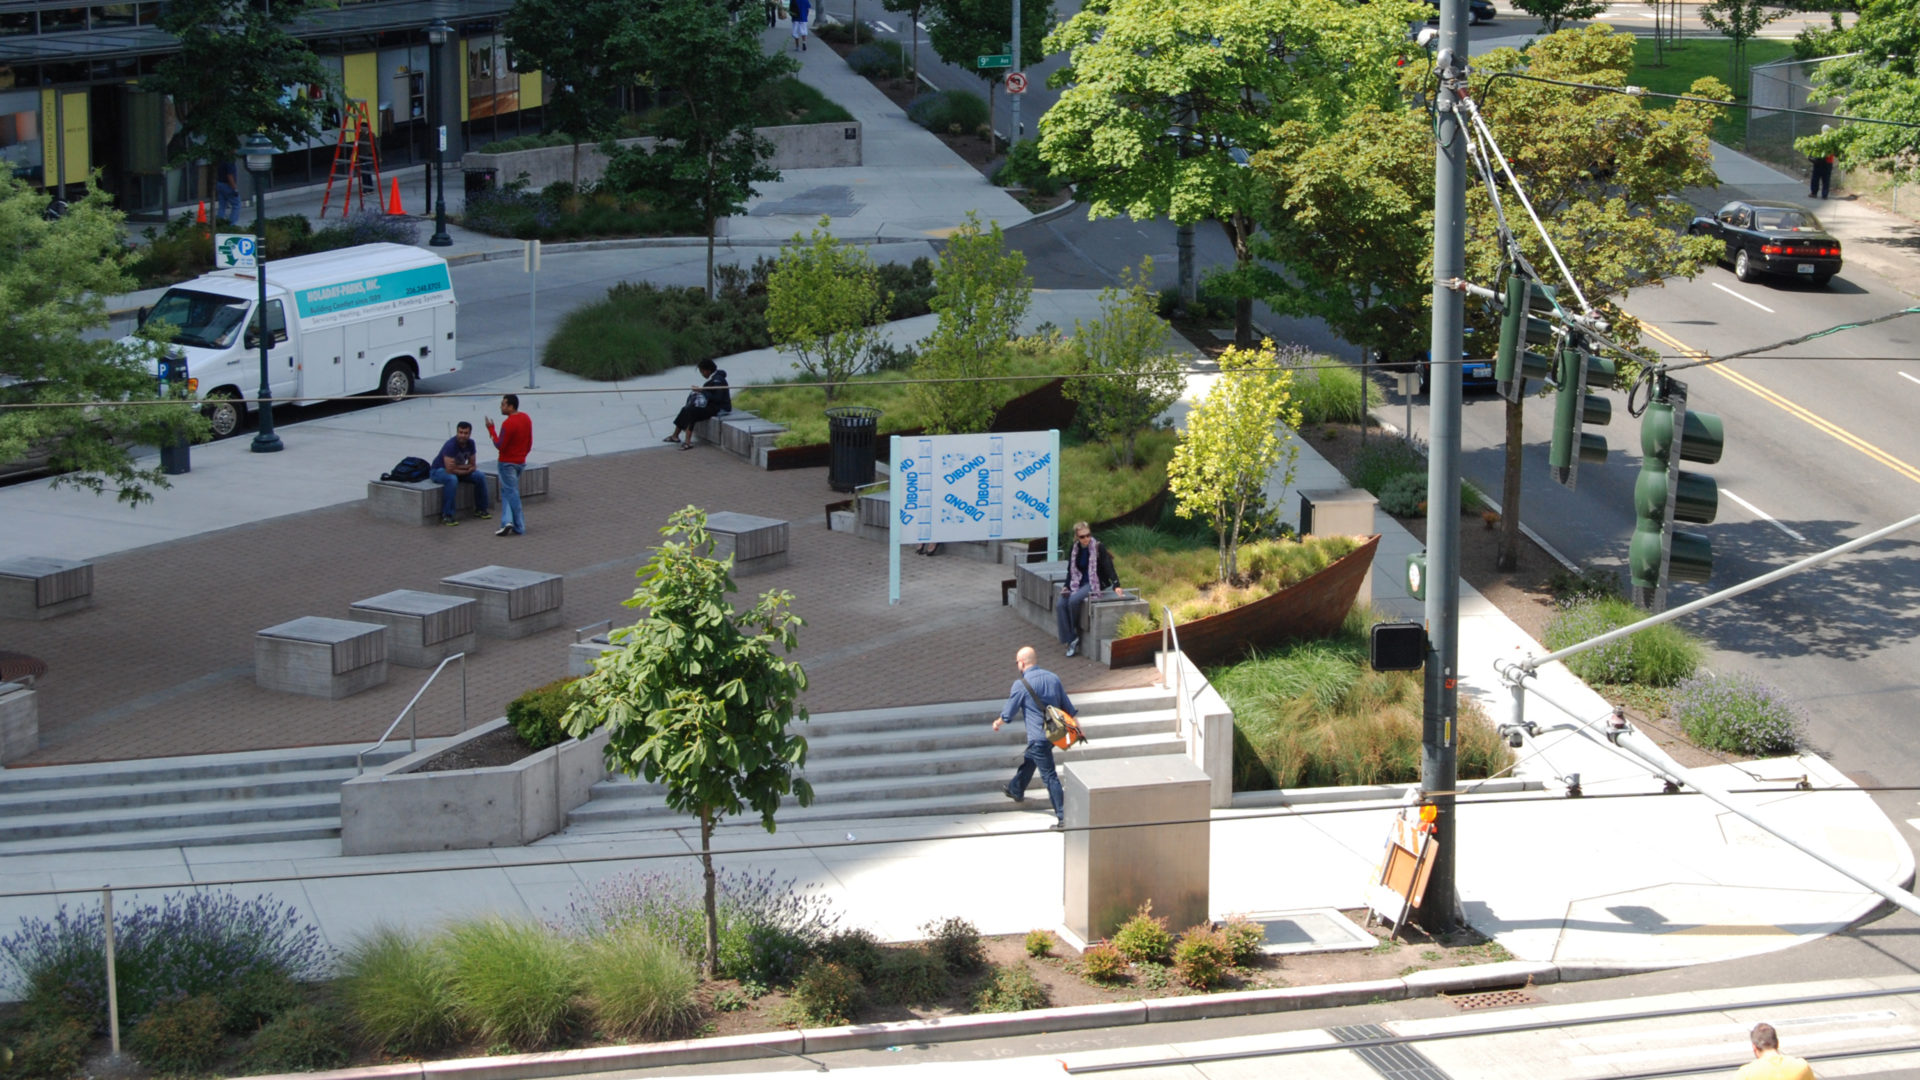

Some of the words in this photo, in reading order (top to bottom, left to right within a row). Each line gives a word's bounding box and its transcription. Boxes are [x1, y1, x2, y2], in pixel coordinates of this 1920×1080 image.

[242, 240, 252, 254] P
[310, 303, 332, 313] Building
[333, 300, 354, 309] Comfort
[160, 364, 166, 376] P
[943, 455, 986, 485] DIBOND
[904, 471, 918, 510] DIBOND
[976, 468, 989, 507] DIBOND
[944, 493, 986, 522] DIBOND
